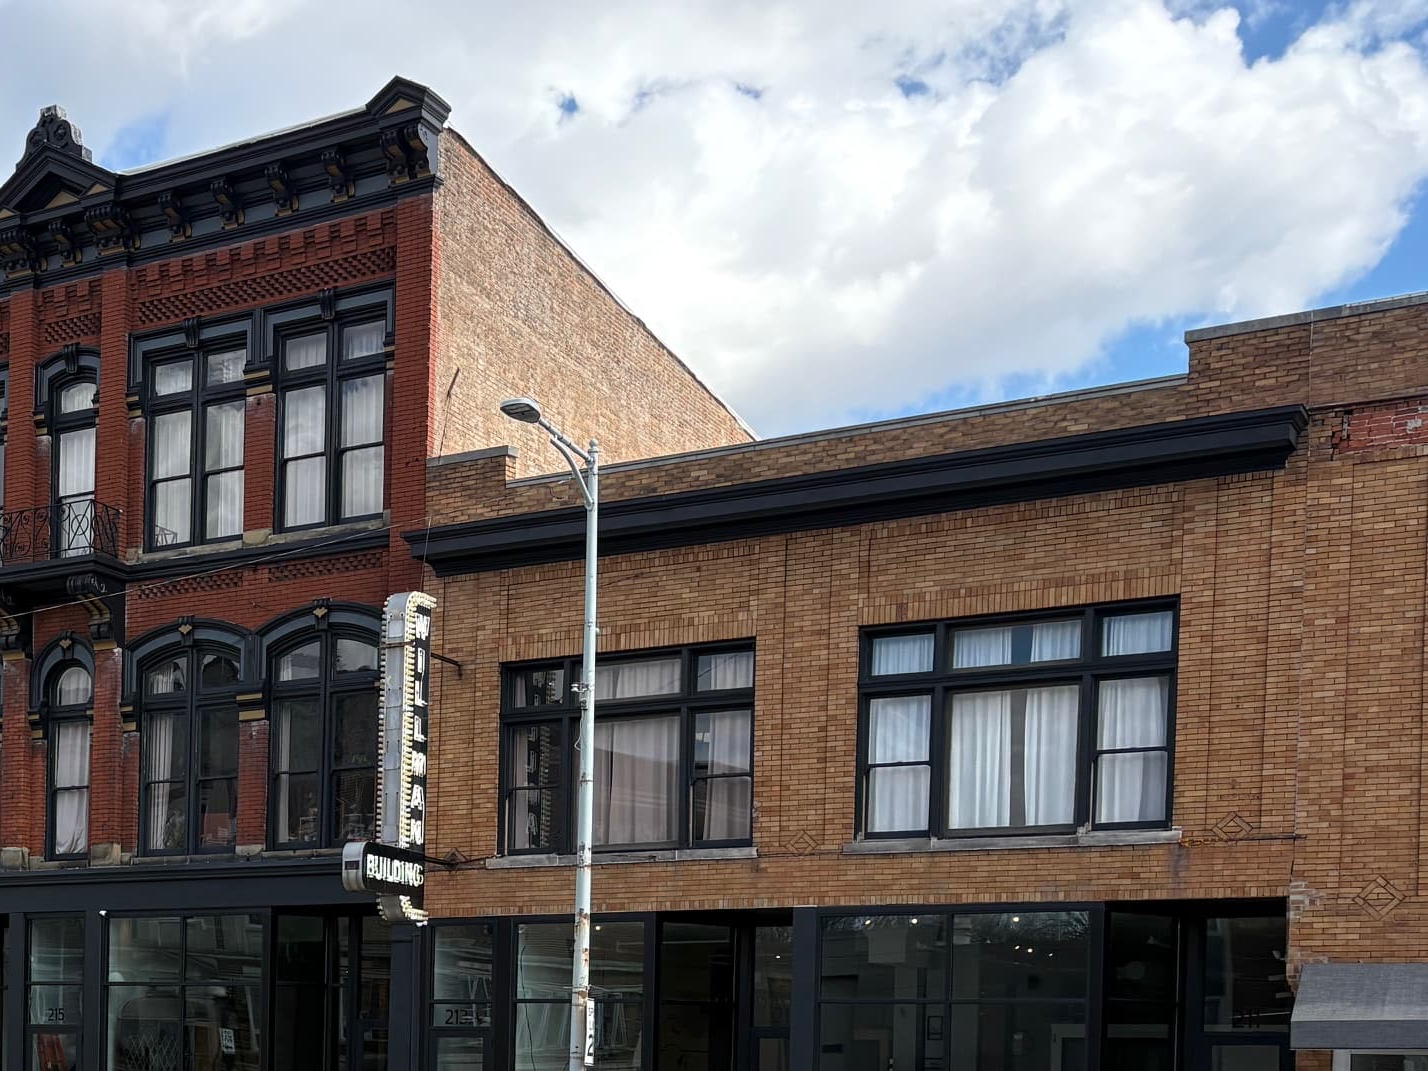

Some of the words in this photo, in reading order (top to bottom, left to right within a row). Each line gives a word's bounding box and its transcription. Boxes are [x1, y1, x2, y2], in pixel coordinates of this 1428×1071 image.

[411, 612, 430, 846] WILLMAN
[366, 853, 423, 887] BUILDING
[47, 1008, 65, 1022] 215
